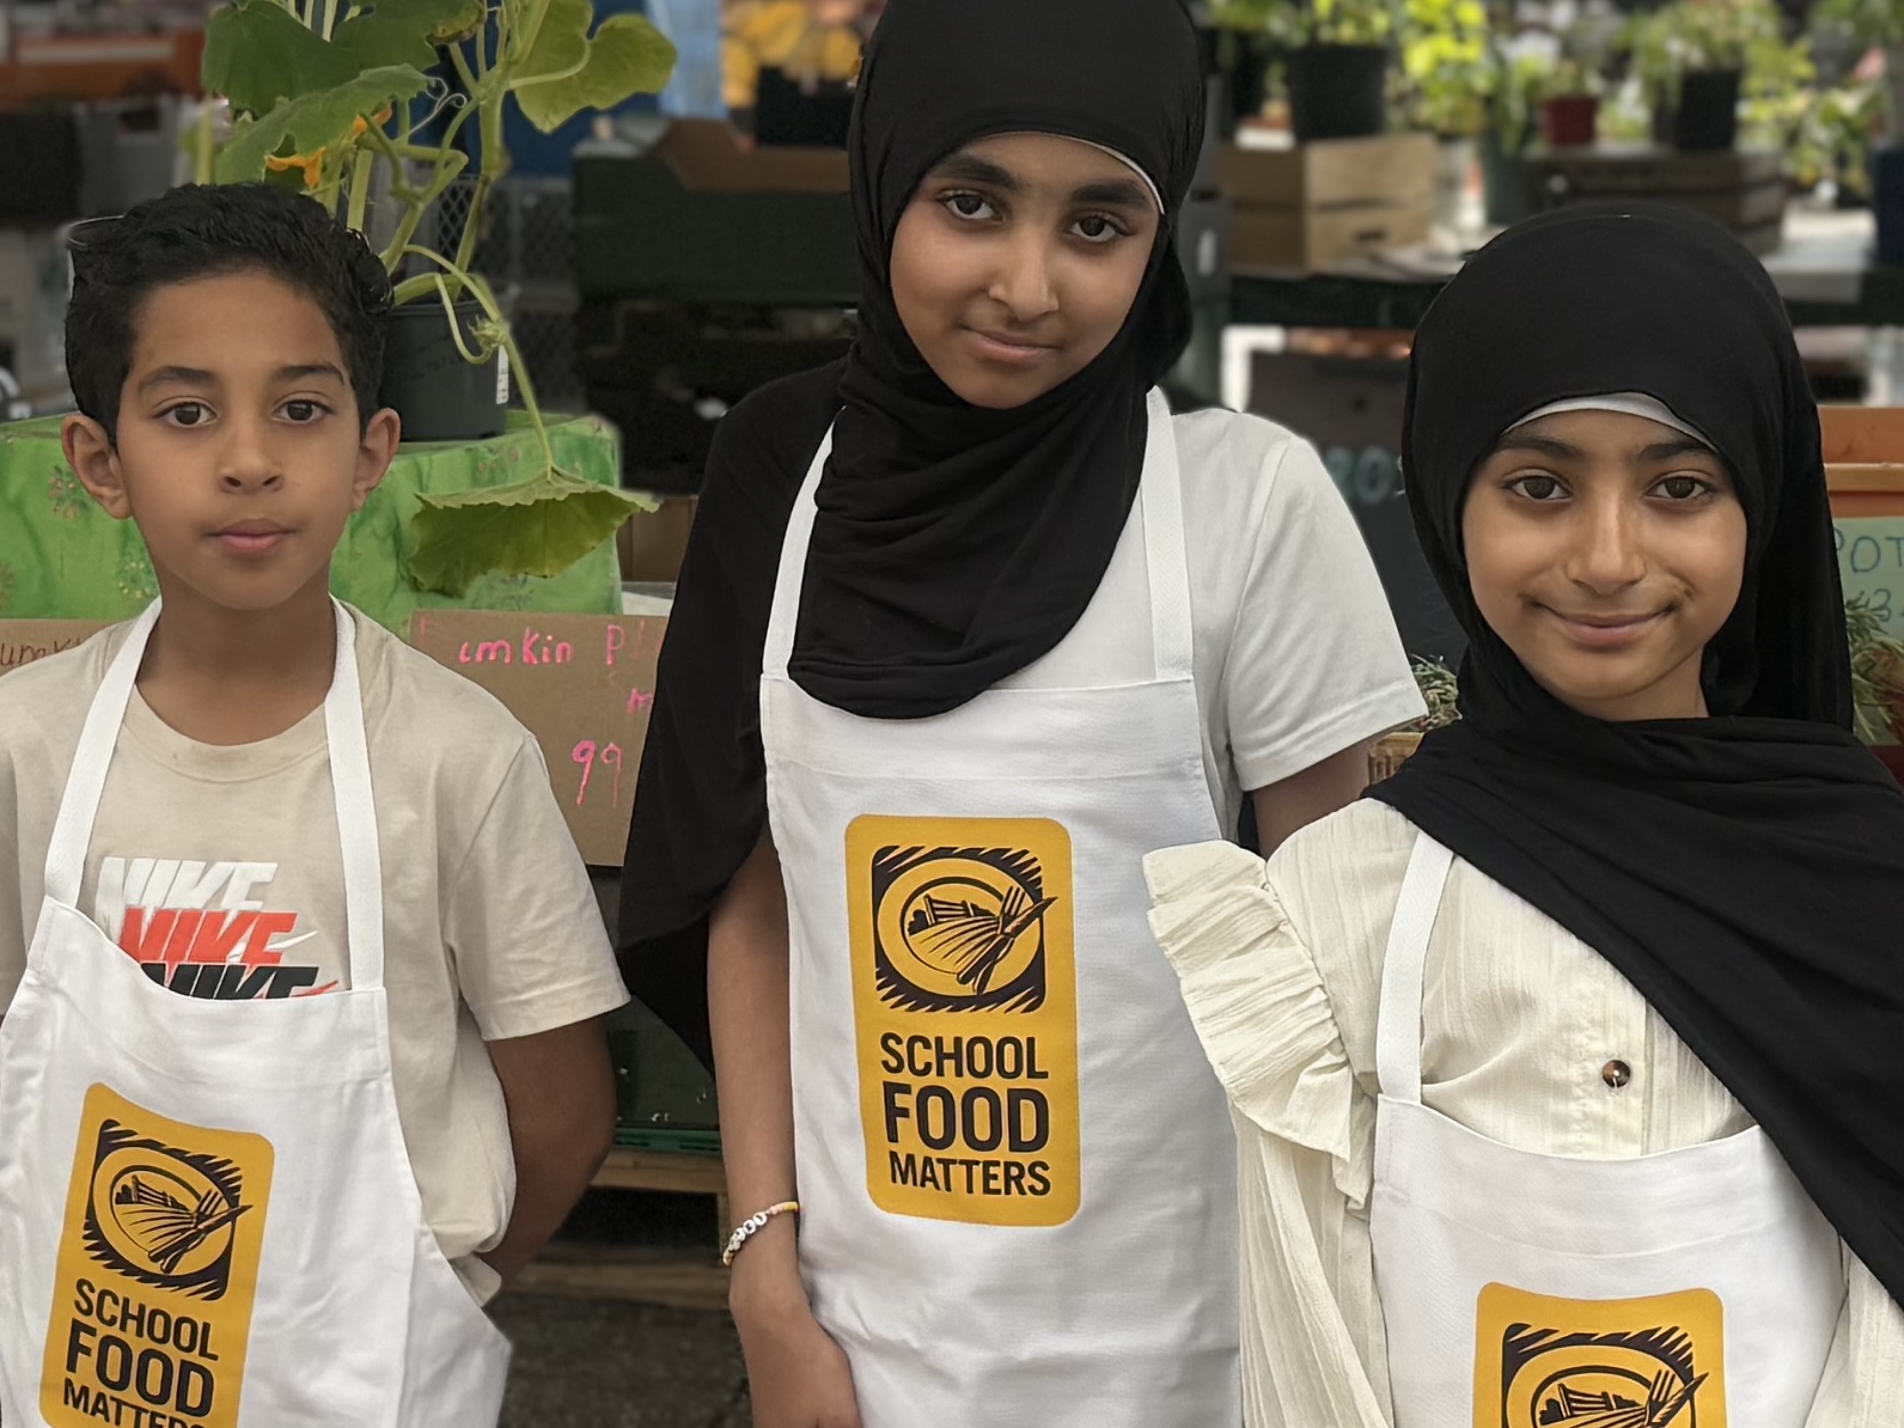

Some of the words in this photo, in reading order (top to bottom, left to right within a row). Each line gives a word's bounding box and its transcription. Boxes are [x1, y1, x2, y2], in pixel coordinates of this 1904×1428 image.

[95, 856, 279, 922] NIKE
[119, 906, 299, 965] NIKE
[880, 1032, 1050, 1080] SCHOOL
[882, 1079, 1051, 1154] FOOD
[888, 1150, 1052, 1198] MATTERS
[73, 1277, 220, 1362] SCHOOL
[65, 1316, 215, 1418] FOOD
